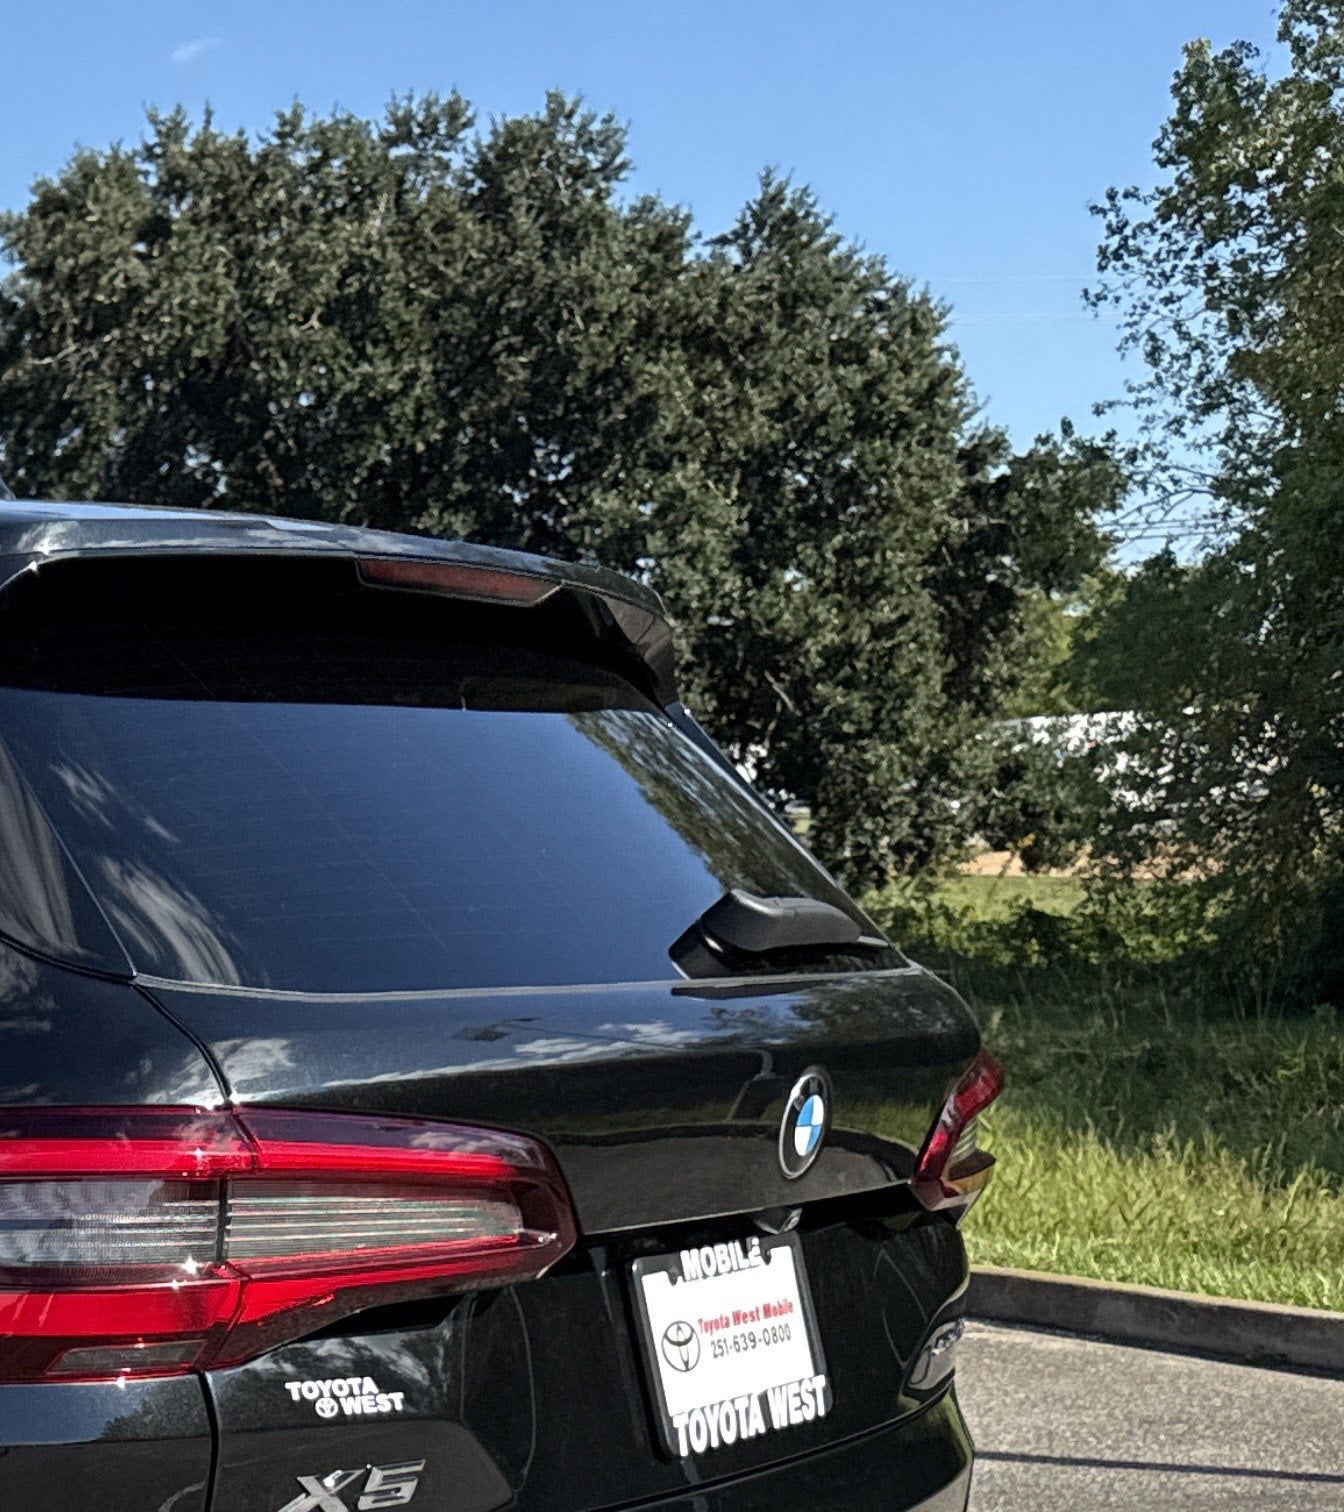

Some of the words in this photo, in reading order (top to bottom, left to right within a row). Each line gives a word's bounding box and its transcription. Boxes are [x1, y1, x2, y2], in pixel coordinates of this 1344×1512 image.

[698, 1314, 730, 1336] Toyota
[732, 1306, 760, 1326] West
[763, 1298, 794, 1319] Mobile
[710, 1323, 792, 1359] 251-639-0800
[285, 1376, 379, 1401] TOYOTA
[339, 1392, 404, 1415] WEST
[673, 1391, 766, 1457] TOYOTA
[767, 1374, 826, 1430] WEST
